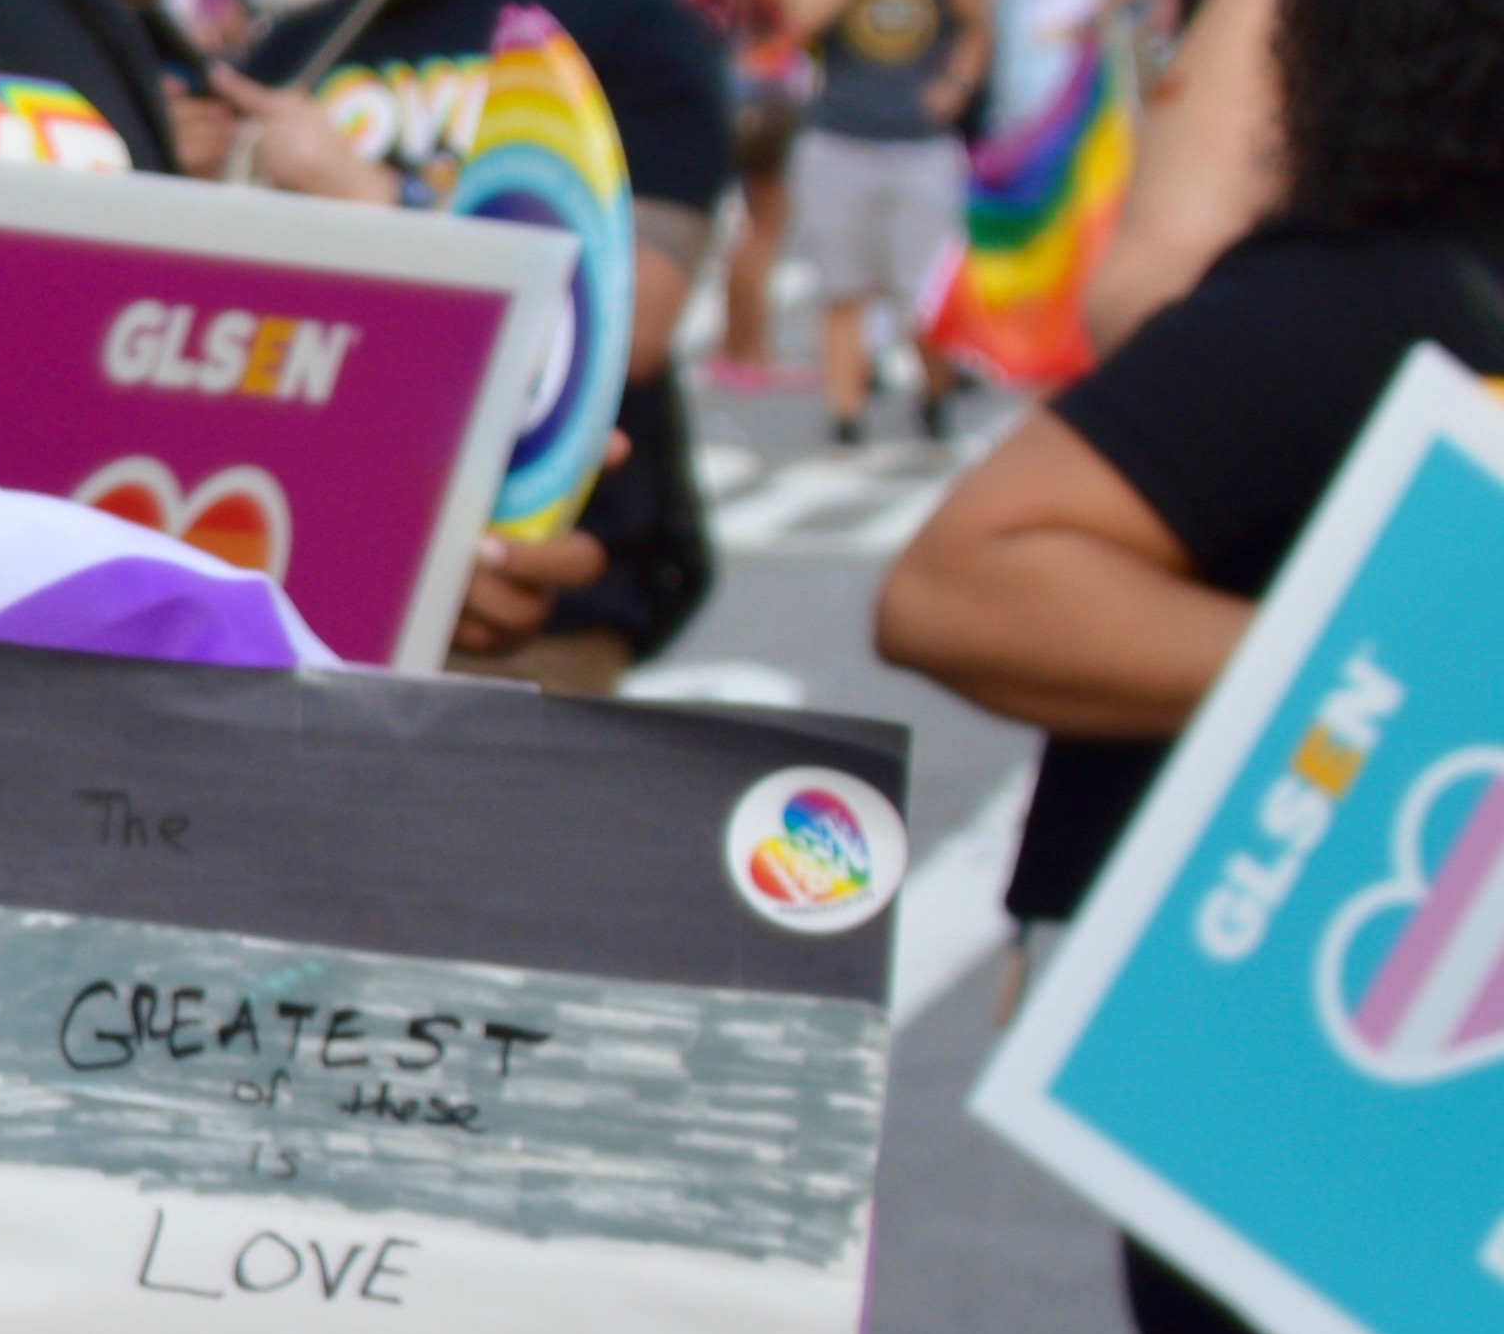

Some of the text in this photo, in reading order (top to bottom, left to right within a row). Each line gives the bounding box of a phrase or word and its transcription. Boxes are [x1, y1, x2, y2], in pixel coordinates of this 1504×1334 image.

[314, 55, 490, 165] OV
[76, 787, 190, 850] The
[59, 980, 552, 1075] GREATEST
[137, 1207, 420, 1306] LOVE
